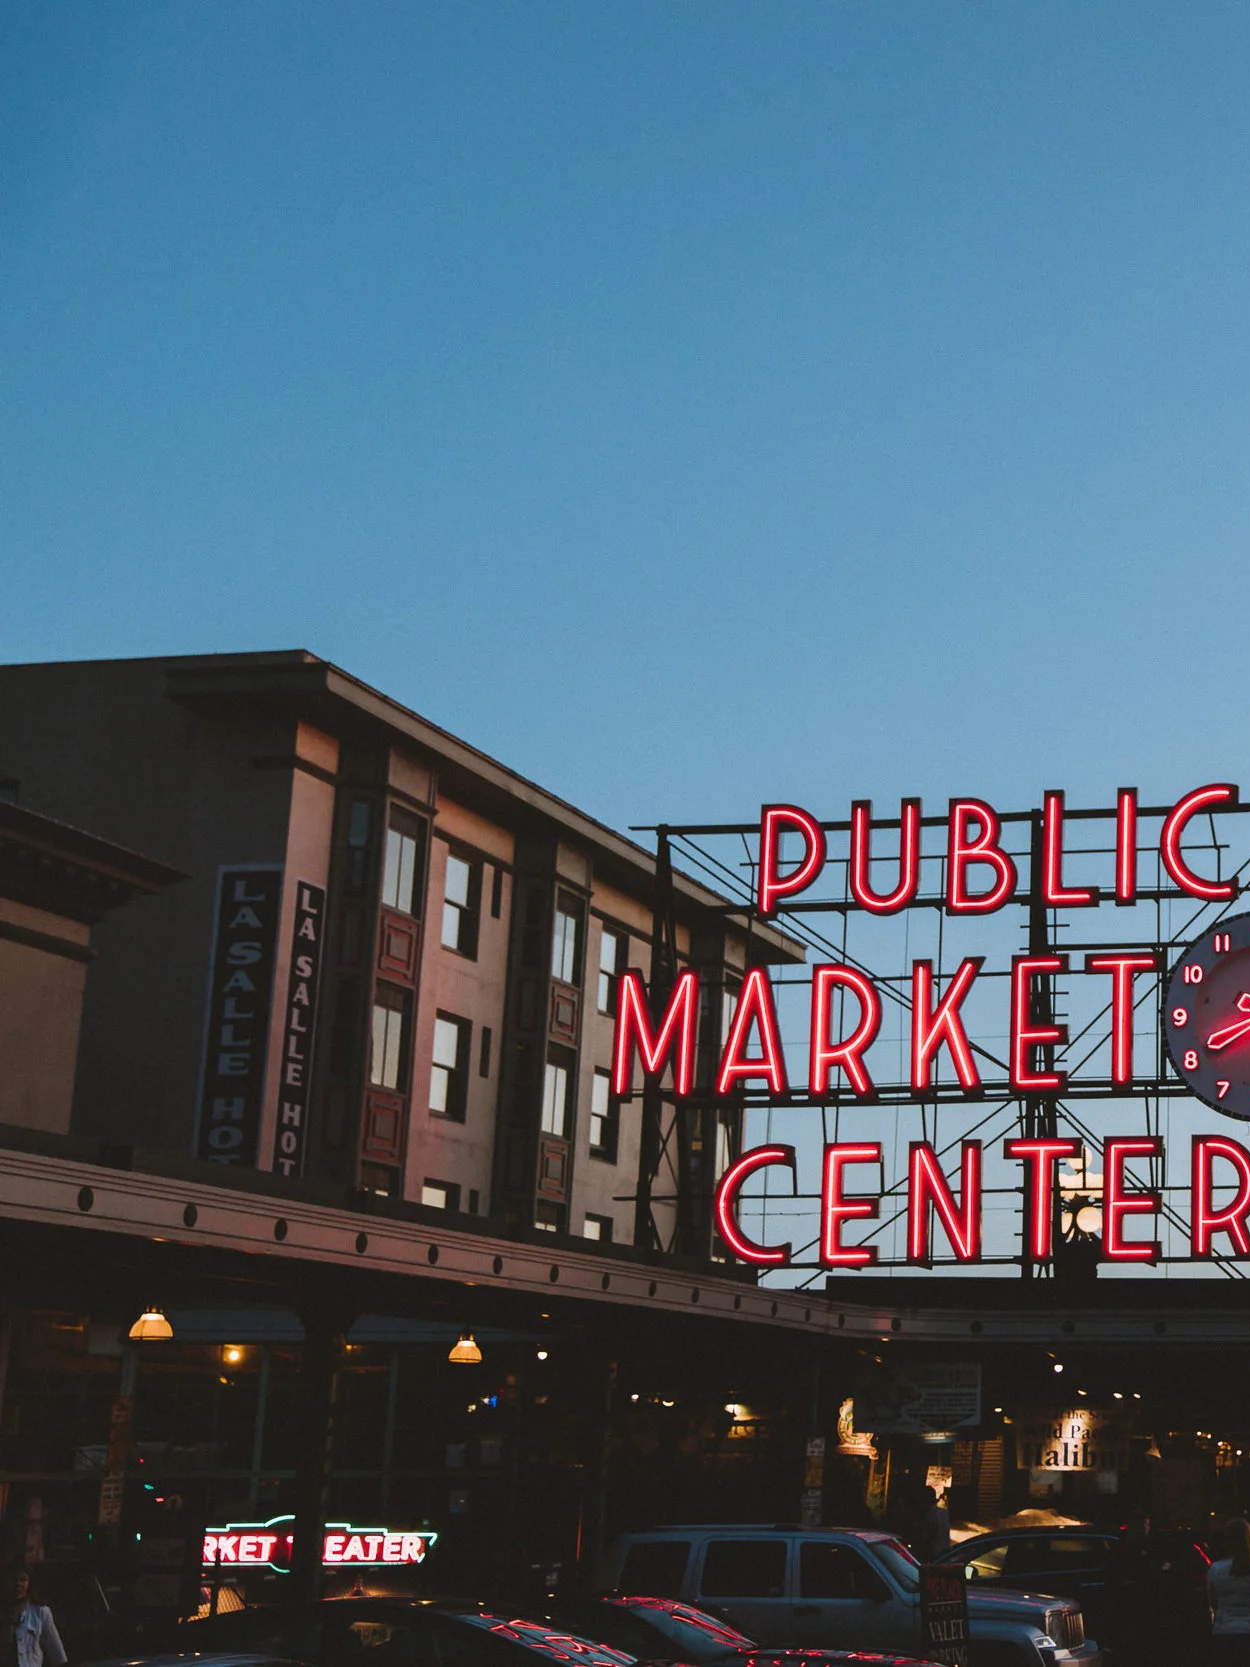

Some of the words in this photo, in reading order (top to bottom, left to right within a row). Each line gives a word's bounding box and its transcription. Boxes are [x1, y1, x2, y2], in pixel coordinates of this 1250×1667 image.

[759, 785, 1238, 916] PUBLIC
[229, 880, 265, 928] LA
[298, 888, 318, 942] LA
[1214, 934, 1230, 952] 11
[1184, 965, 1203, 984] 10
[217, 941, 263, 1075] SALLE
[286, 956, 314, 1087] SALLE
[611, 955, 1162, 1098] MARKET
[1173, 1008, 1188, 1026] 9
[1184, 1050, 1198, 1069] 8
[1217, 1081, 1230, 1098] 7
